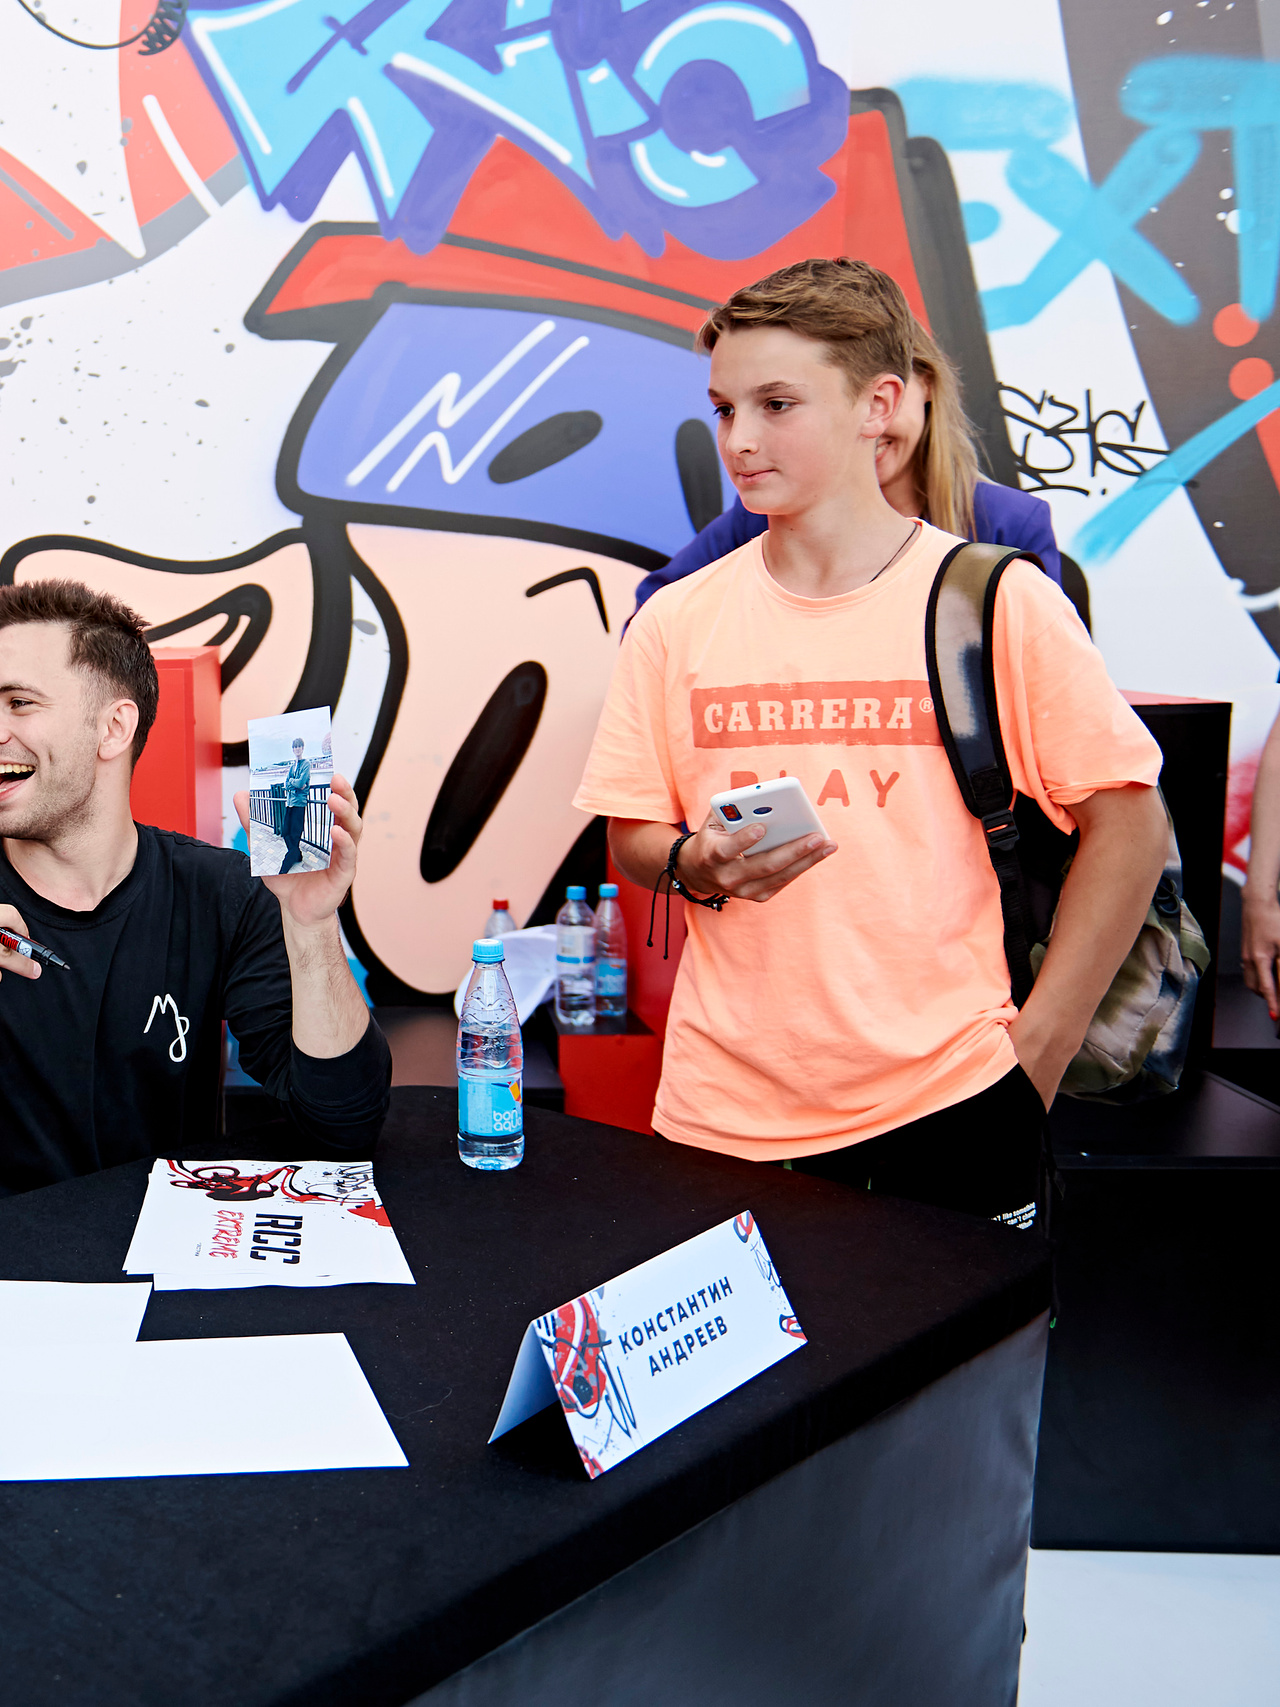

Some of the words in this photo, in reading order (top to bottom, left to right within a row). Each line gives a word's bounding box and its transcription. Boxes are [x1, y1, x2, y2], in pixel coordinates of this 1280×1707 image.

[730, 768, 900, 808] AY
[493, 1109, 518, 1122] bon
[208, 1209, 245, 1260] EXTREME
[249, 1212, 304, 1265] RCC
[618, 1276, 734, 1354] КОНСТАНТИН
[648, 1315, 729, 1377] АНДРЕЕВ
